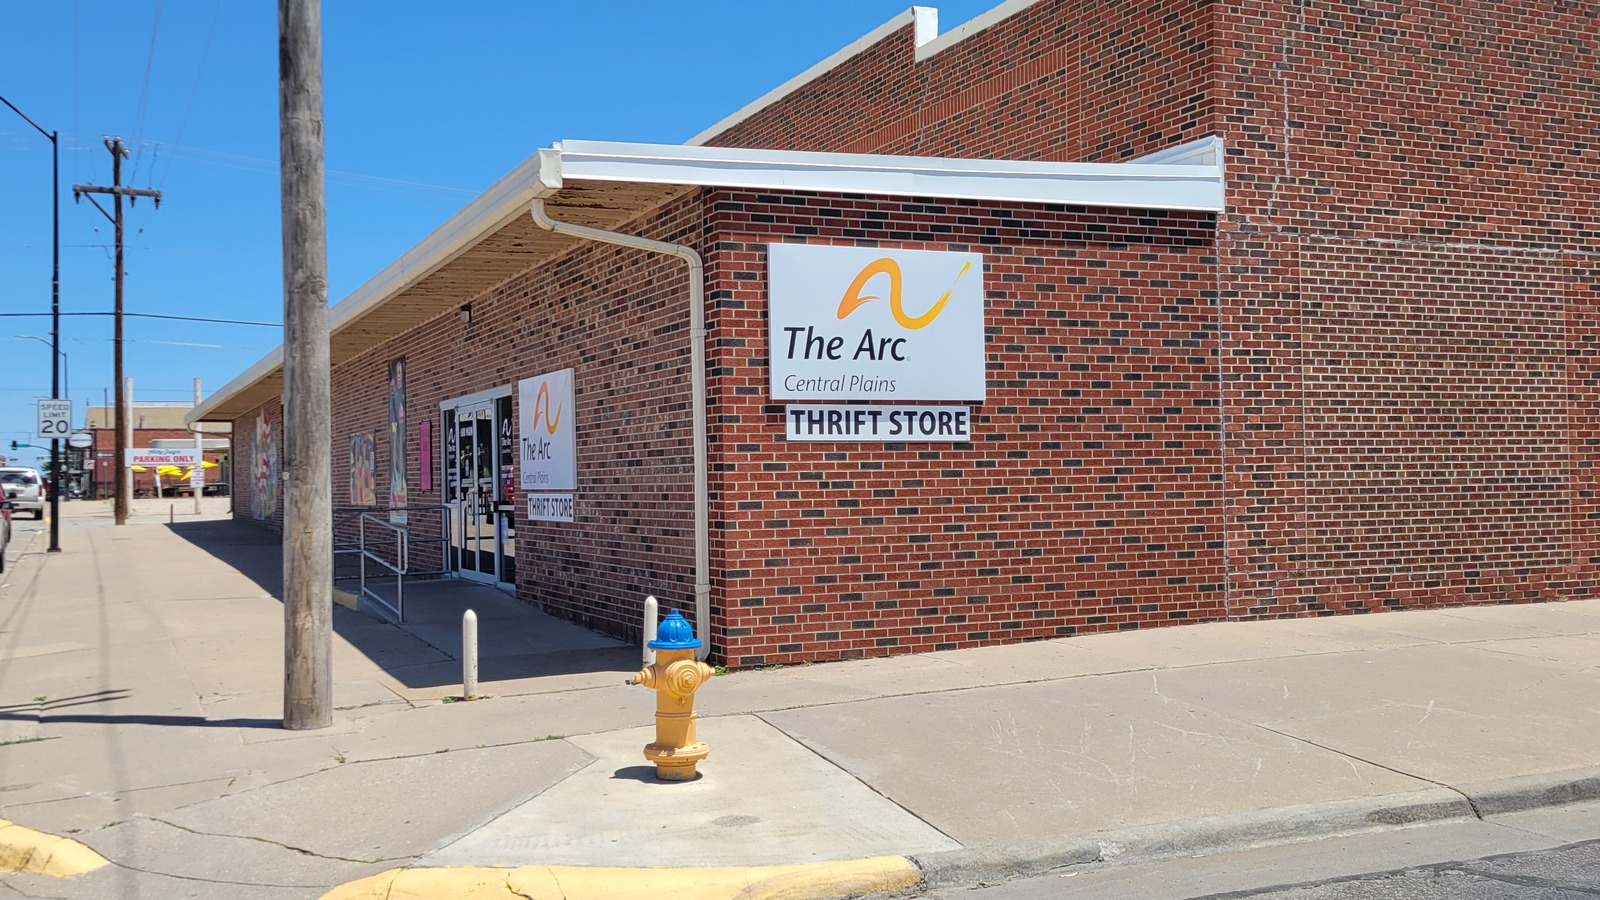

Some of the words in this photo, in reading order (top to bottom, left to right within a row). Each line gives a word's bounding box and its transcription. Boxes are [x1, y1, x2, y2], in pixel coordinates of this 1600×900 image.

[783, 326, 844, 361] The
[852, 328, 907, 362] Arc
[784, 374, 845, 392] Central
[849, 374, 896, 393] Plains
[41, 420, 69, 434] 20
[790, 410, 882, 436] THRIFT
[889, 410, 967, 436] STORE
[522, 437, 536, 461] The
[537, 435, 551, 460] Arc
[133, 455, 170, 463] PARKING
[173, 455, 194, 463] ONLY
[523, 471, 537, 484] Central
[537, 471, 549, 484] Plains
[528, 497, 550, 517] THRIFT
[551, 497, 573, 518] STORE
